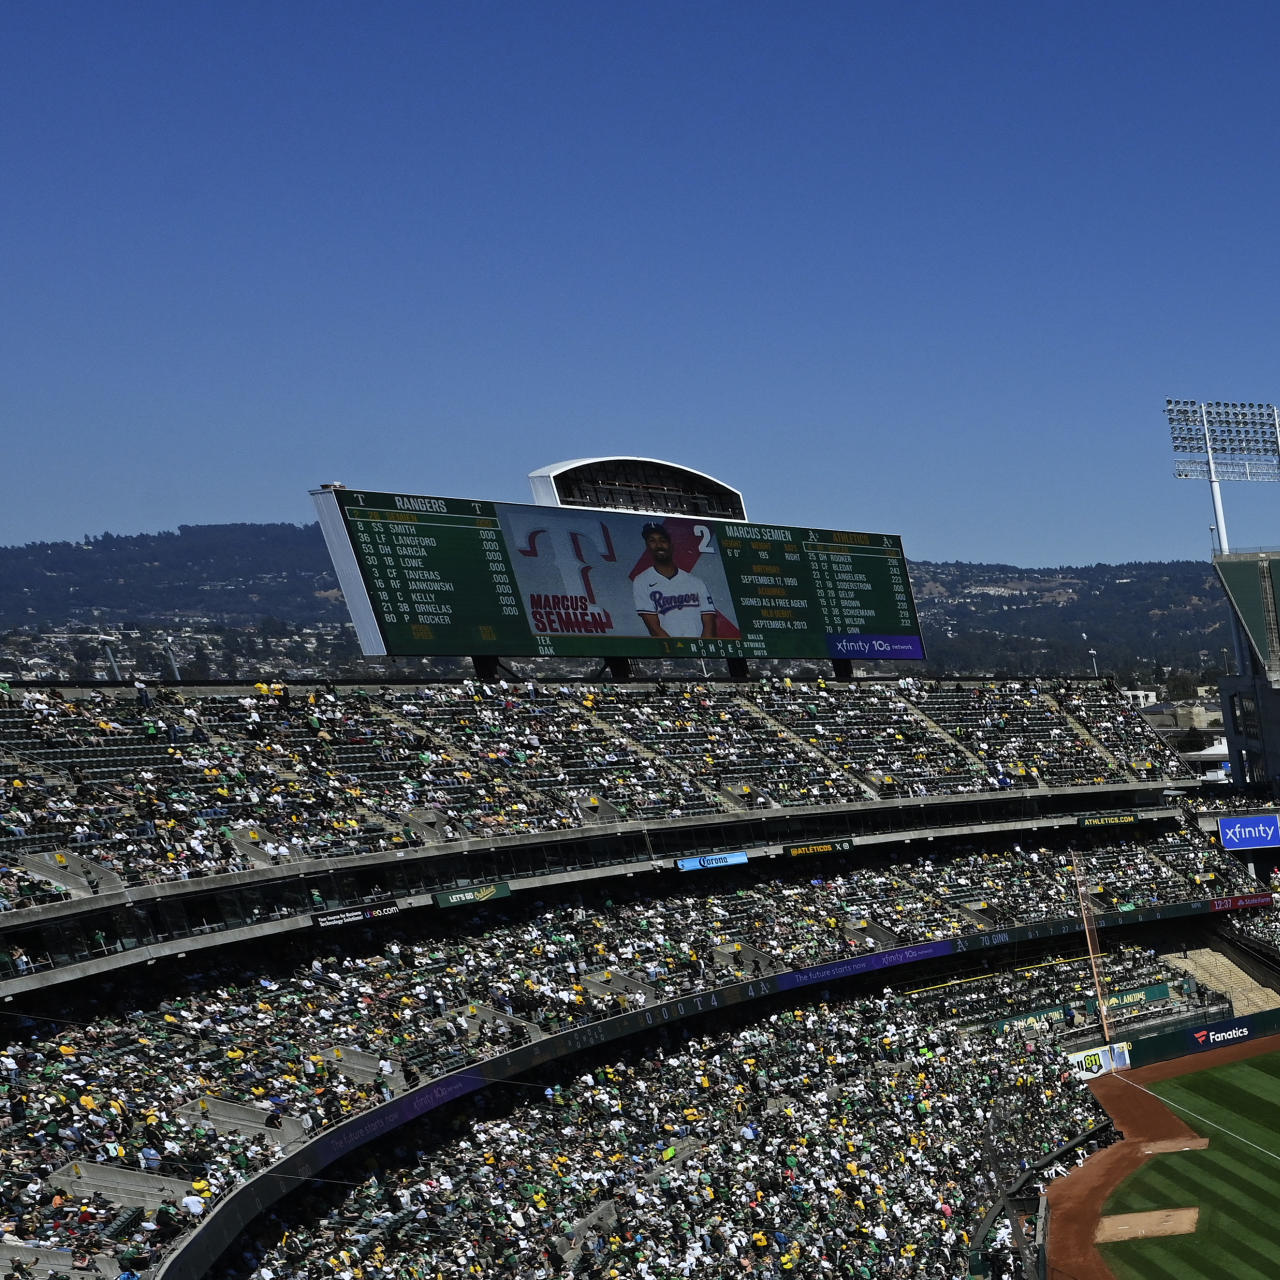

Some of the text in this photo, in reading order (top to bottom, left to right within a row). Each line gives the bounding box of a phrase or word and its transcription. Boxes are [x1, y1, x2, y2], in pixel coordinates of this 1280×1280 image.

[395, 496, 448, 513] RANGERS
[389, 524, 416, 534] SMITH
[393, 536, 437, 547] LANGFORD
[693, 525, 715, 553] 2
[400, 558, 424, 568] LOWE
[404, 570, 441, 580] TAVERAS
[408, 581, 455, 591] JANKOWSKI
[412, 593, 435, 602] KELLY
[530, 594, 589, 612] MARCUS
[415, 604, 453, 614] ORNELAS
[418, 614, 451, 625] ROCKER
[532, 611, 607, 634] SEMIEN
[836, 640, 870, 653] xfinity
[1084, 815, 1134, 826] ATHLETICS.COM
[1224, 824, 1275, 843] xfinity
[699, 856, 728, 868] Corona
[449, 893, 465, 902] LET'S
[465, 892, 474, 900] GO
[1215, 900, 1232, 910] 12:37
[980, 933, 1009, 946] 70 GINN
[881, 952, 904, 967] xfinity
[795, 973, 809, 983] The
[809, 968, 831, 981] future
[1118, 991, 1146, 1005] LANDING
[1209, 1026, 1249, 1043] Fanatics
[1084, 1053, 1100, 1068] 811
